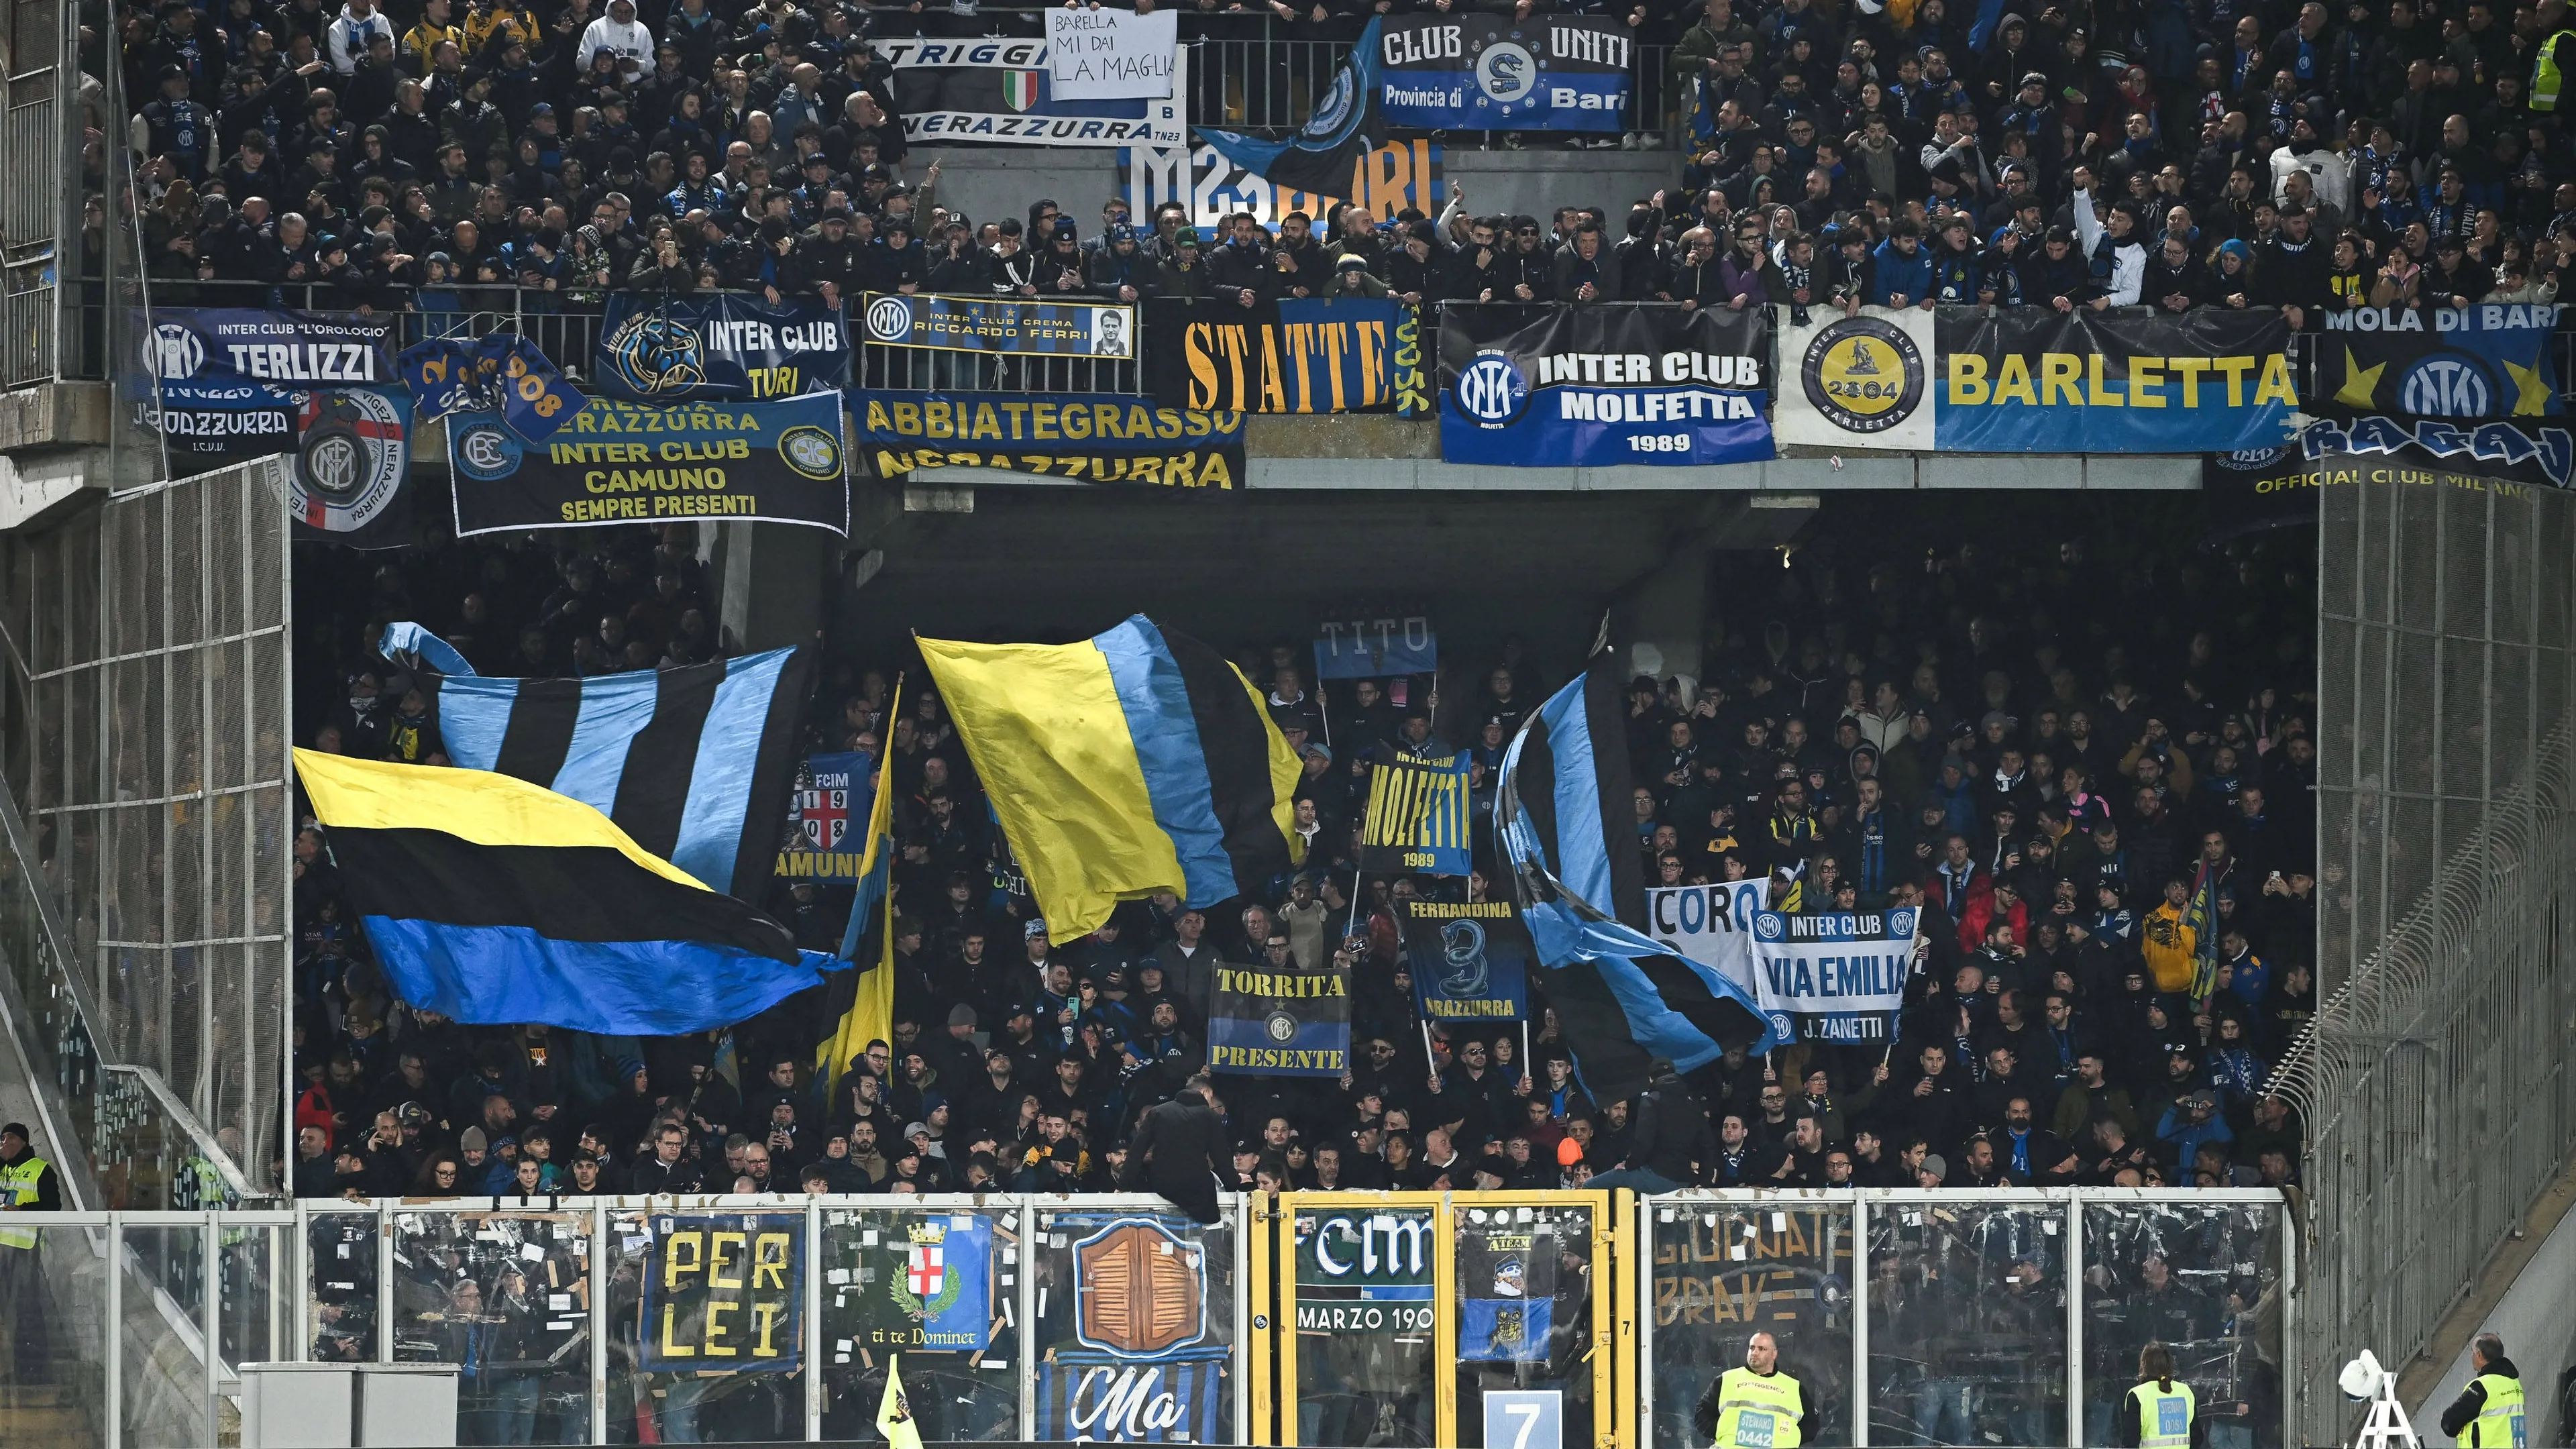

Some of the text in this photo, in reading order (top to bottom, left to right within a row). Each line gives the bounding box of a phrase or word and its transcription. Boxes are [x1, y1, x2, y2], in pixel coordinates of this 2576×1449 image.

[1055, 15, 1118, 32] BARELLA
[1056, 36, 1114, 55] MI DAI
[1383, 25, 1629, 69] CLUB UNITI
[1054, 54, 1175, 83] LA MAGLIA
[1385, 84, 1627, 111] Provincia di Bari
[904, 113, 1152, 140] NERAZZURRA
[1155, 131, 1181, 142] TN23
[218, 323, 257, 335] INTER
[261, 323, 294, 335] CLUB
[914, 321, 1088, 340] RICCARDO FERRI
[929, 313, 1073, 328] INTER CLUB CREMA
[2325, 306, 2423, 332] MOLA
[2435, 307, 2470, 331] DI
[709, 321, 838, 352] INTER CLUB
[1808, 329, 1919, 364] INTER CLUB
[227, 343, 374, 380] TERLIZZI
[1184, 321, 1389, 414] STATTE
[1538, 352, 1760, 386] INTER CLUB
[749, 366, 798, 398] TURI
[1948, 352, 2300, 410] BARLETTA
[362, 393, 396, 440] VIGEZZO
[1560, 390, 1756, 423] MOLFETTA
[1821, 404, 1907, 429] BARLETTA
[556, 413, 761, 433] RAZZURRA
[867, 399, 1242, 441] ABBIATEGRASSO
[551, 439, 751, 465] INTER CLUB
[1627, 433, 1690, 452] 1989
[351, 443, 397, 522] NERAZZURRA
[585, 467, 726, 493] CAMUNO
[2255, 470, 2360, 494] OFFICIAL
[562, 494, 756, 521] SEMPRE PRESENTI
[814, 773, 849, 788] FCIM
[1362, 763, 1470, 850] MOLFETTA
[1403, 852, 1436, 867] 1989
[1409, 902, 1512, 919] FERRANDINA
[1654, 883, 1760, 935] CORO
[1791, 914, 1881, 936] INTER CLUB
[1217, 968, 1346, 999] TORRITA
[1763, 955, 1907, 998] VIA EMILIA
[1425, 997, 1515, 1018] NRAZZURRA
[1211, 1044, 1344, 1070] PRESENTE
[664, 1231, 790, 1290] PER
[662, 1301, 780, 1358] LEI
[1297, 1307, 1434, 1329] MARZO 190
[1622, 1320, 1631, 1336] 7
[872, 1328, 977, 1345] ti te Dominet
[1071, 1366, 1185, 1438] Ma
[1505, 1403, 1542, 1449] 7
[1740, 1413, 1772, 1430] STEWARD
[1737, 1429, 1772, 1447] 0442
